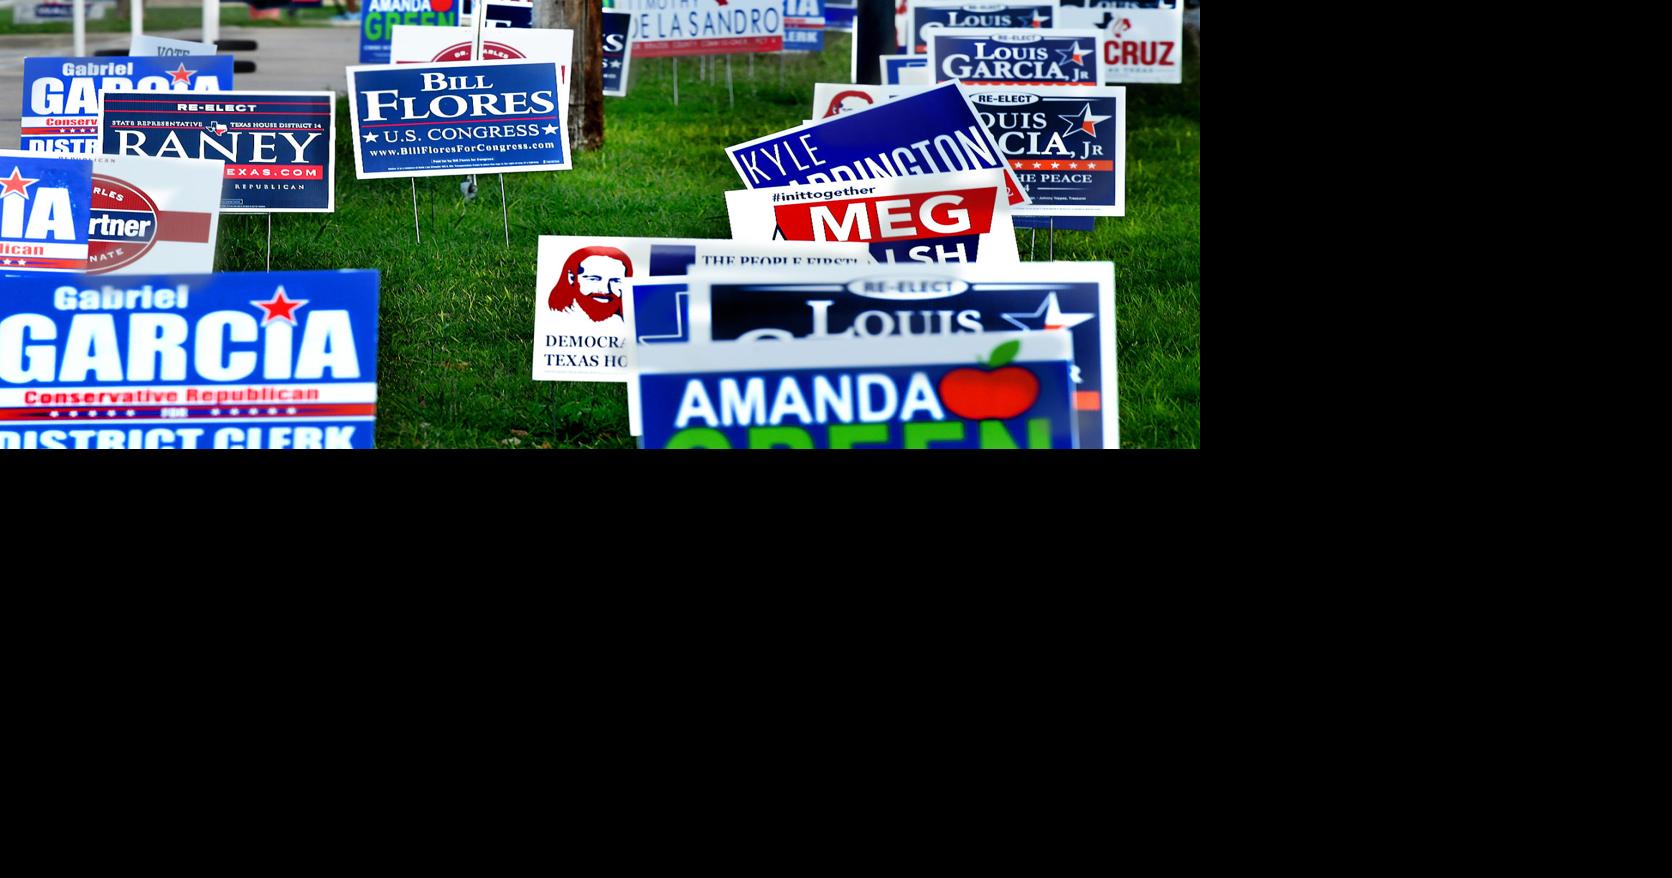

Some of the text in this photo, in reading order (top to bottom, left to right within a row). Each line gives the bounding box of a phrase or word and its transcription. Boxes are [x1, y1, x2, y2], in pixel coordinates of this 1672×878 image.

[974, 42, 1049, 60] LOUIS
[1104, 40, 1175, 66] CRUZ
[62, 62, 133, 77] Gabriel
[942, 54, 1069, 80] GARCIA,
[420, 72, 493, 91] BILL
[177, 104, 257, 112] RE-ELECT
[360, 89, 554, 121] FLORES
[978, 95, 1032, 103] RE-ELECT
[980, 112, 1047, 129] OUIS
[384, 124, 540, 143] U.S. CONGRESS
[115, 130, 322, 164] RANEY
[369, 142, 555, 156] www.BillFloresForCongress.com
[998, 131, 1075, 158] CIA,
[740, 133, 826, 184] KYLE
[1041, 174, 1093, 183] PEACE
[772, 185, 876, 202] #inittogether
[809, 194, 972, 242] MEG
[863, 280, 953, 293] RE-ELECT
[54, 284, 189, 310] Gabriel
[807, 300, 984, 339] LOUIS
[0, 309, 361, 384] GARCIA
[544, 353, 599, 367] TEXAS
[24, 386, 320, 406] Conservative Republican
[674, 372, 945, 429] AMANDA
[213, 426, 356, 449] CLERK
